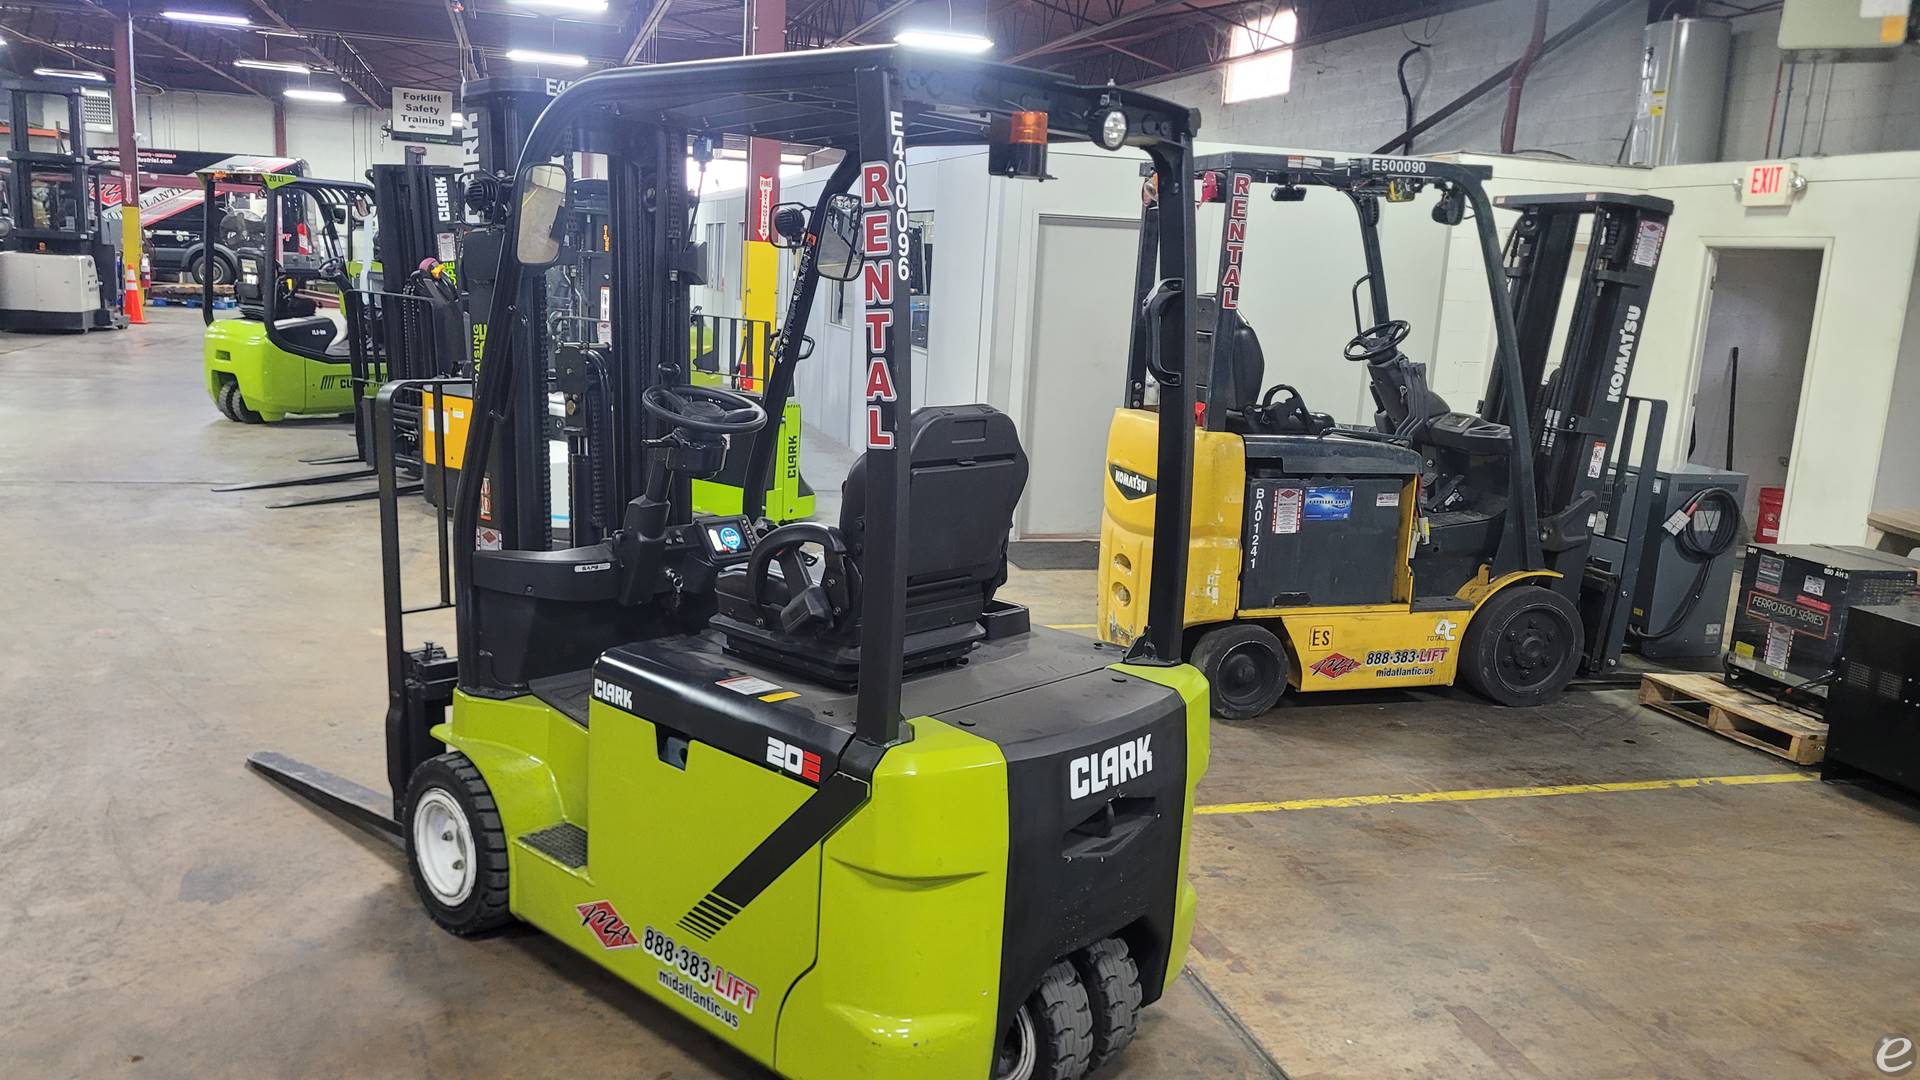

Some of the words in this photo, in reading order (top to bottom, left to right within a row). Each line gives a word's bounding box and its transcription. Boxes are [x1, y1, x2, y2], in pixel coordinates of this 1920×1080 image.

[403, 92, 442, 103] Forklift
[405, 103, 440, 115] Safety
[400, 114, 445, 127] Training
[1372, 159, 1427, 173] E500090
[1751, 167, 1783, 193] EXIT
[435, 177, 450, 221] CLARK
[890, 111, 909, 281] E400096
[1222, 173, 1250, 309] RENTAL
[862, 162, 896, 450] RENTAL
[1607, 305, 1641, 403] KOMATSU
[787, 435, 797, 478] CLARK
[1115, 469, 1147, 493] KOMATSU
[1250, 488, 1265, 569] BA01241
[1798, 610, 1824, 626] SERIES
[1312, 630, 1330, 646] ES
[1376, 666, 1434, 677] midatlantic.us
[594, 678, 633, 710] CLARK
[1070, 733, 1153, 800] CLARK
[658, 970, 739, 1028] midatlantic.us
